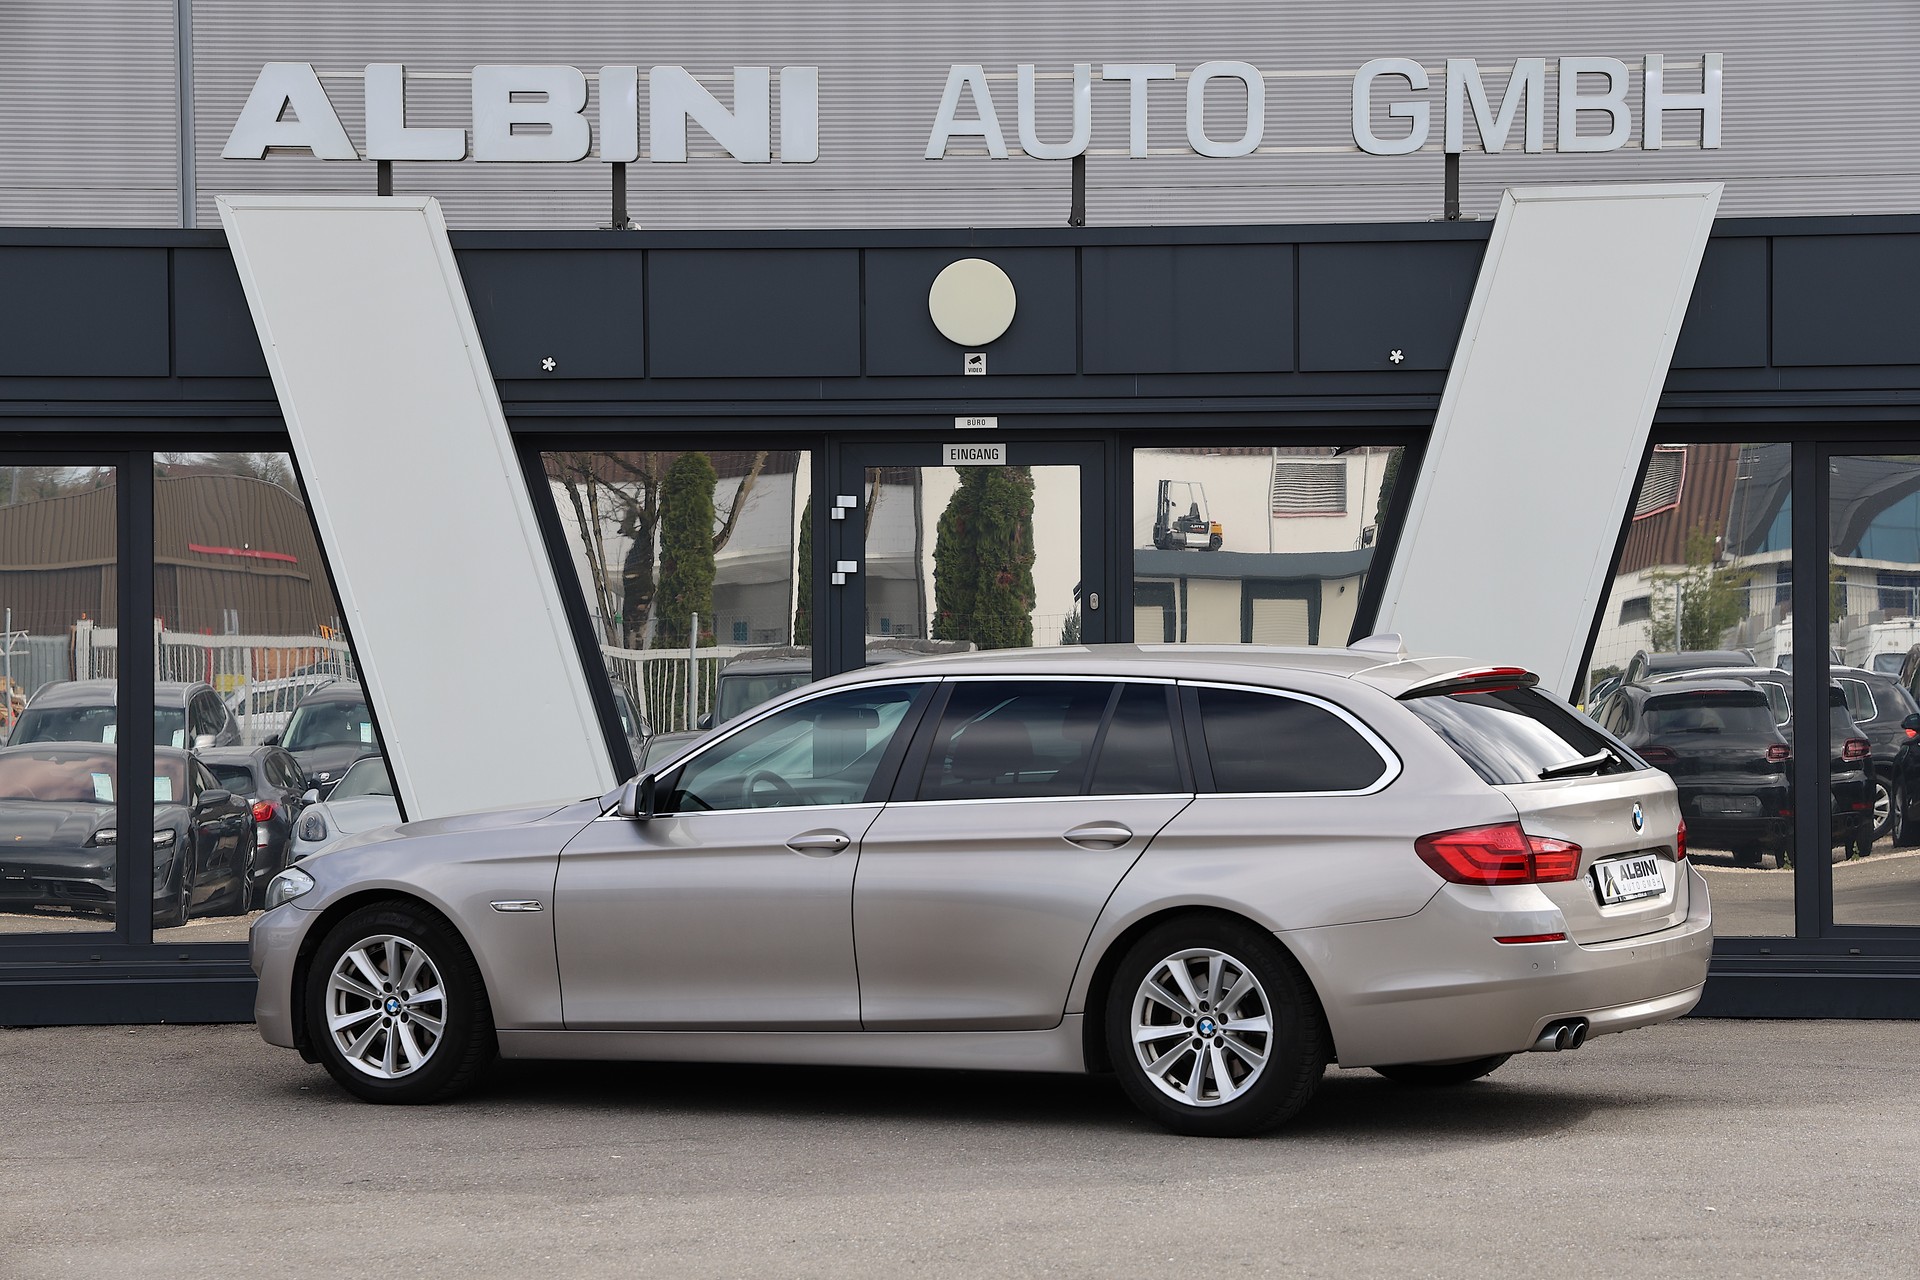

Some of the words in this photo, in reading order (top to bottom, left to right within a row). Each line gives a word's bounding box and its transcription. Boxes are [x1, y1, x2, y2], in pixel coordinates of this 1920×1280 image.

[220, 62, 820, 164] ALBINI
[924, 60, 1266, 160] AUTO
[1350, 52, 1725, 156] GMBH
[967, 418, 986, 426] BÜRO
[950, 448, 999, 460] EINGANG
[1620, 859, 1658, 881] ALBINI
[1622, 881, 1640, 893] AUTO
